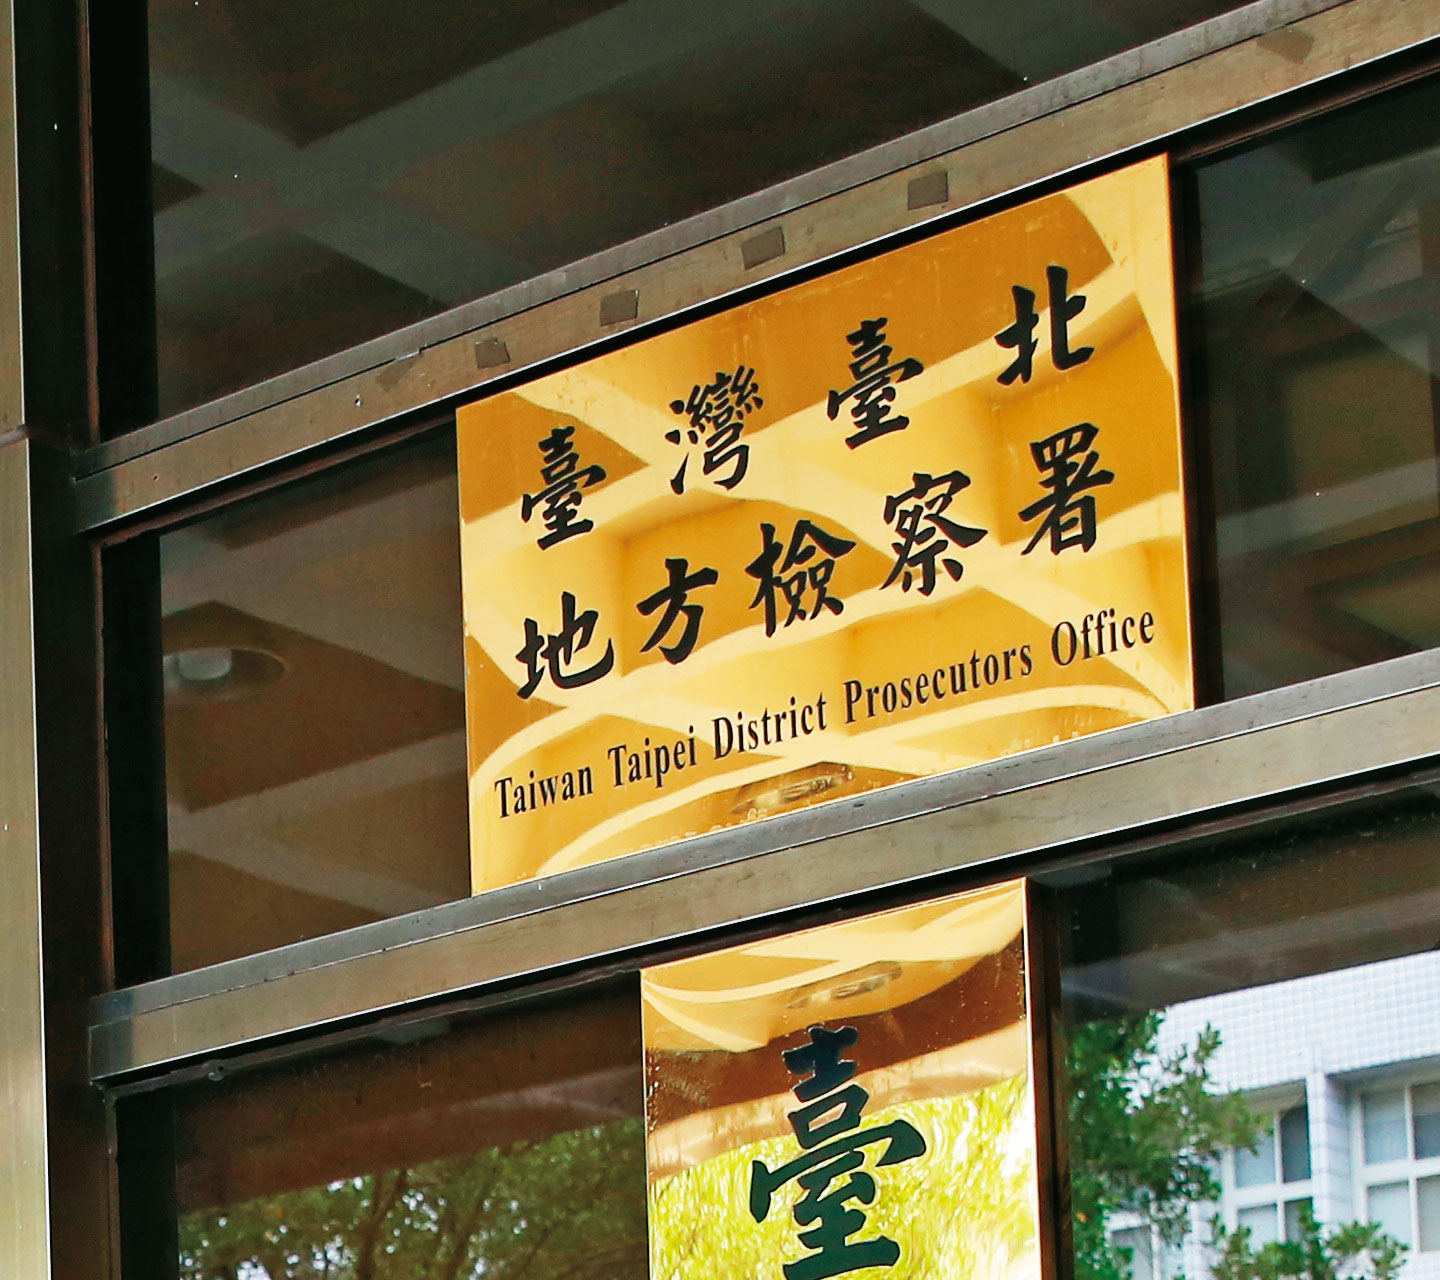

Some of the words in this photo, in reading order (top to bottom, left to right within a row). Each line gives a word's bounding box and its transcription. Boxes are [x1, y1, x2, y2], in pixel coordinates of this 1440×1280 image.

[522, 266, 1093, 550] 臺灣臺北
[515, 423, 1115, 699] 地方檢察署
[495, 767, 592, 820] Taiwan
[608, 726, 697, 787] Taipei
[714, 696, 826, 758] District
[843, 646, 1033, 724] Prosecutors
[1052, 609, 1154, 667] Office
